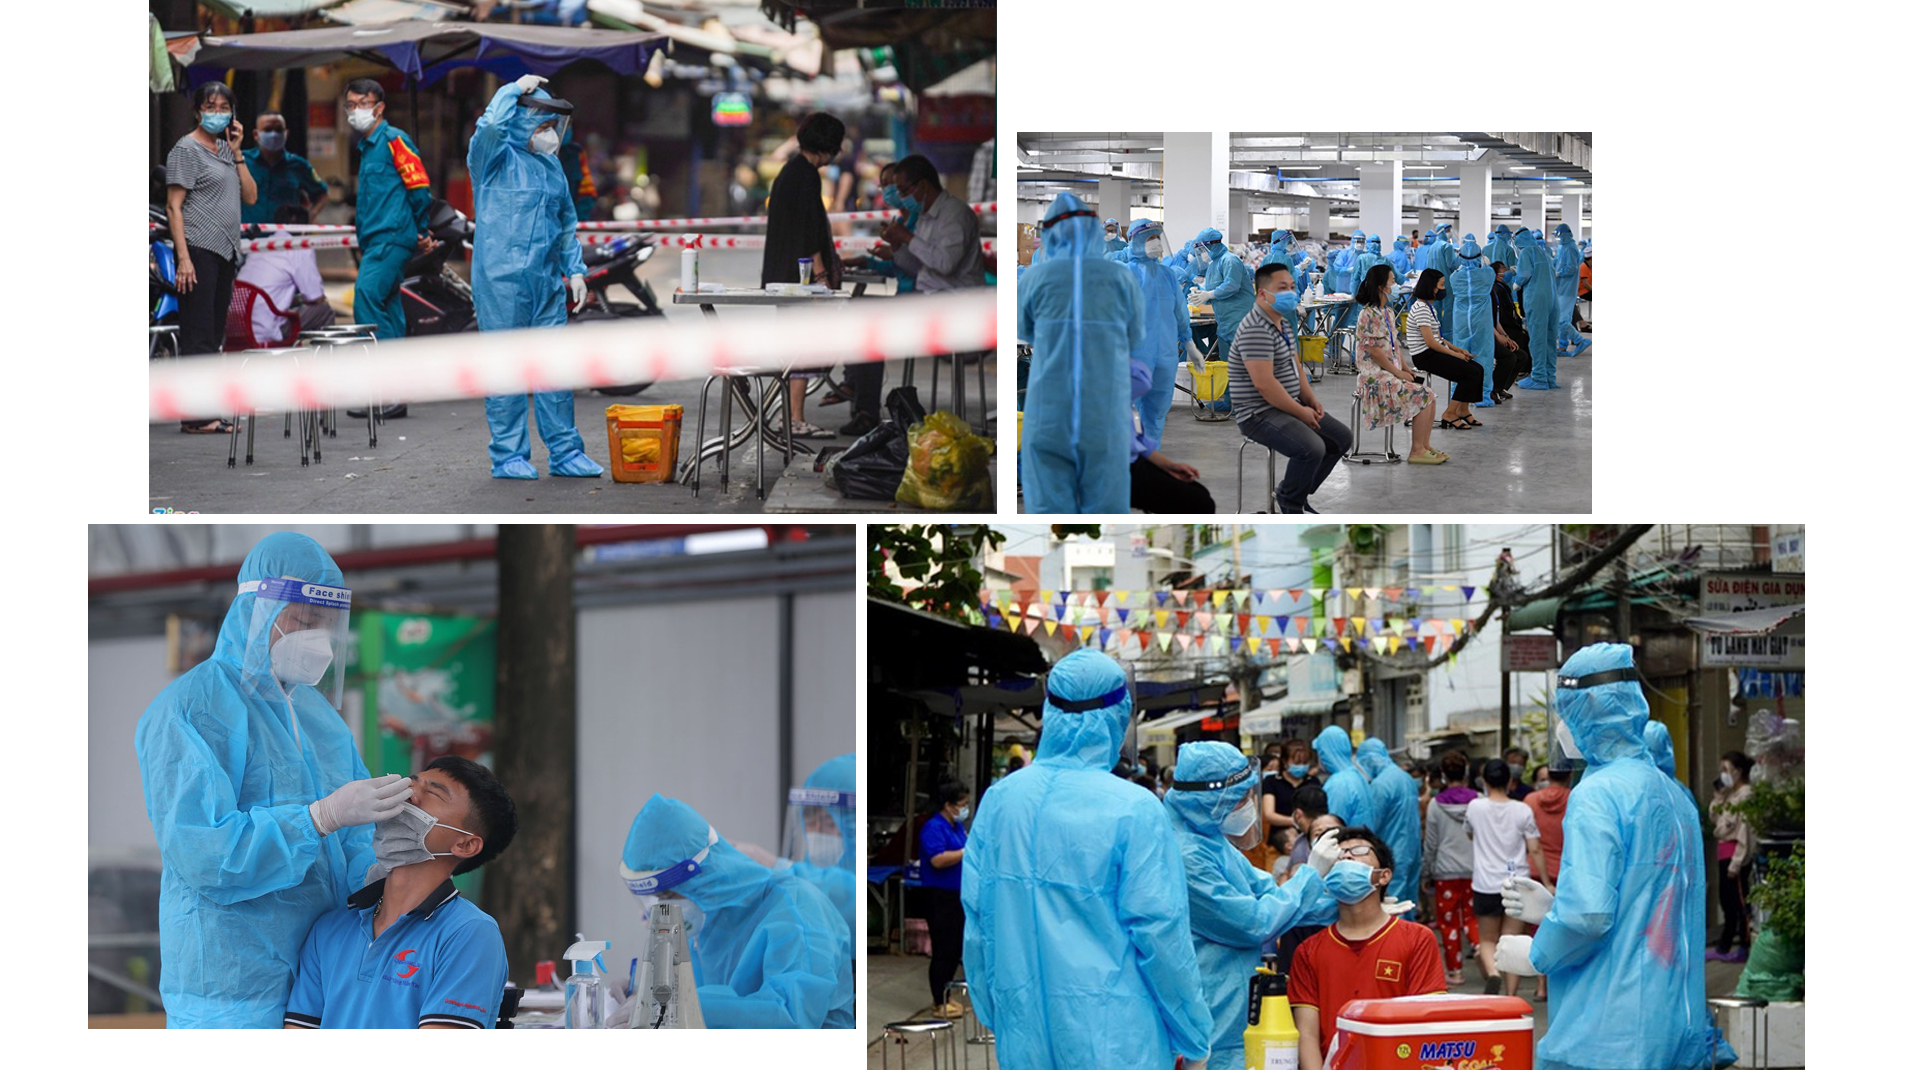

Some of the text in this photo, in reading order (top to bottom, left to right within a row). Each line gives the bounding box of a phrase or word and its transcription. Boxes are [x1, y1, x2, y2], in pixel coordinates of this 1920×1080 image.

[309, 586, 333, 598] Face
[1707, 576, 1729, 594] SỬA
[1732, 578, 1759, 597] ĐIỆN
[1762, 582, 1781, 595] GIA
[1419, 1040, 1477, 1061] MATSU
